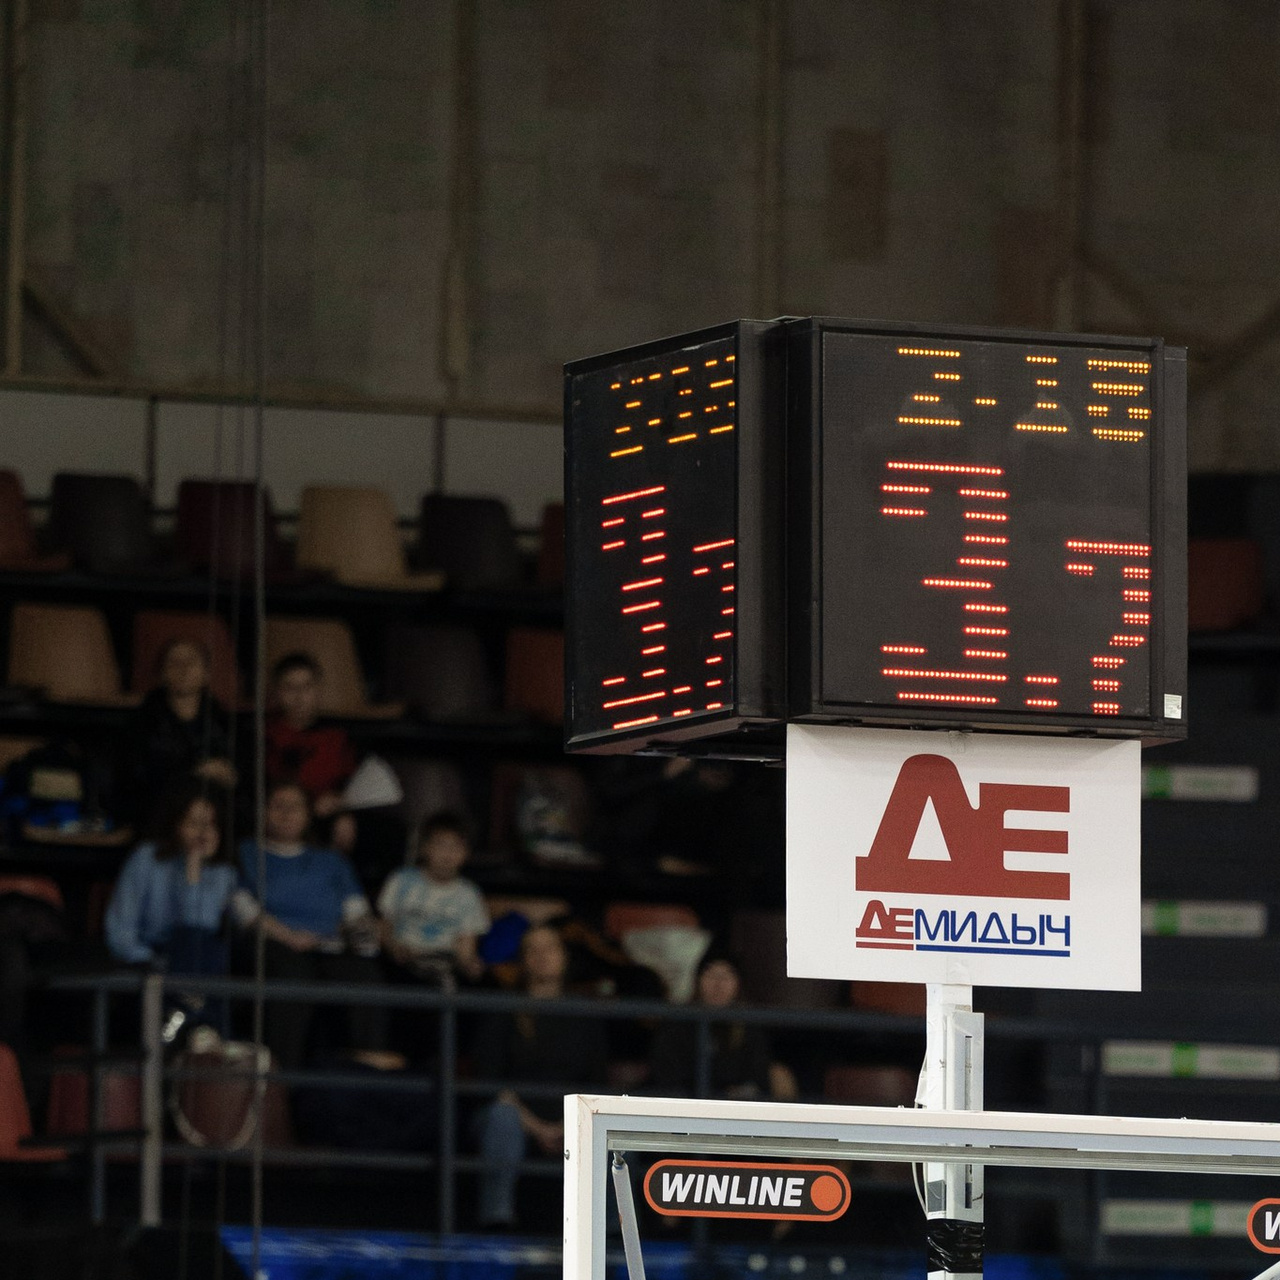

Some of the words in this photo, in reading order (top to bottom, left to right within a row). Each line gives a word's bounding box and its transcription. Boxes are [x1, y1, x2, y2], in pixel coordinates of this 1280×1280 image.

[879, 460, 1152, 717] 3.7
[855, 899, 1071, 949] ДЕМИДЫЧ
[661, 1170, 805, 1209] WINLINE
